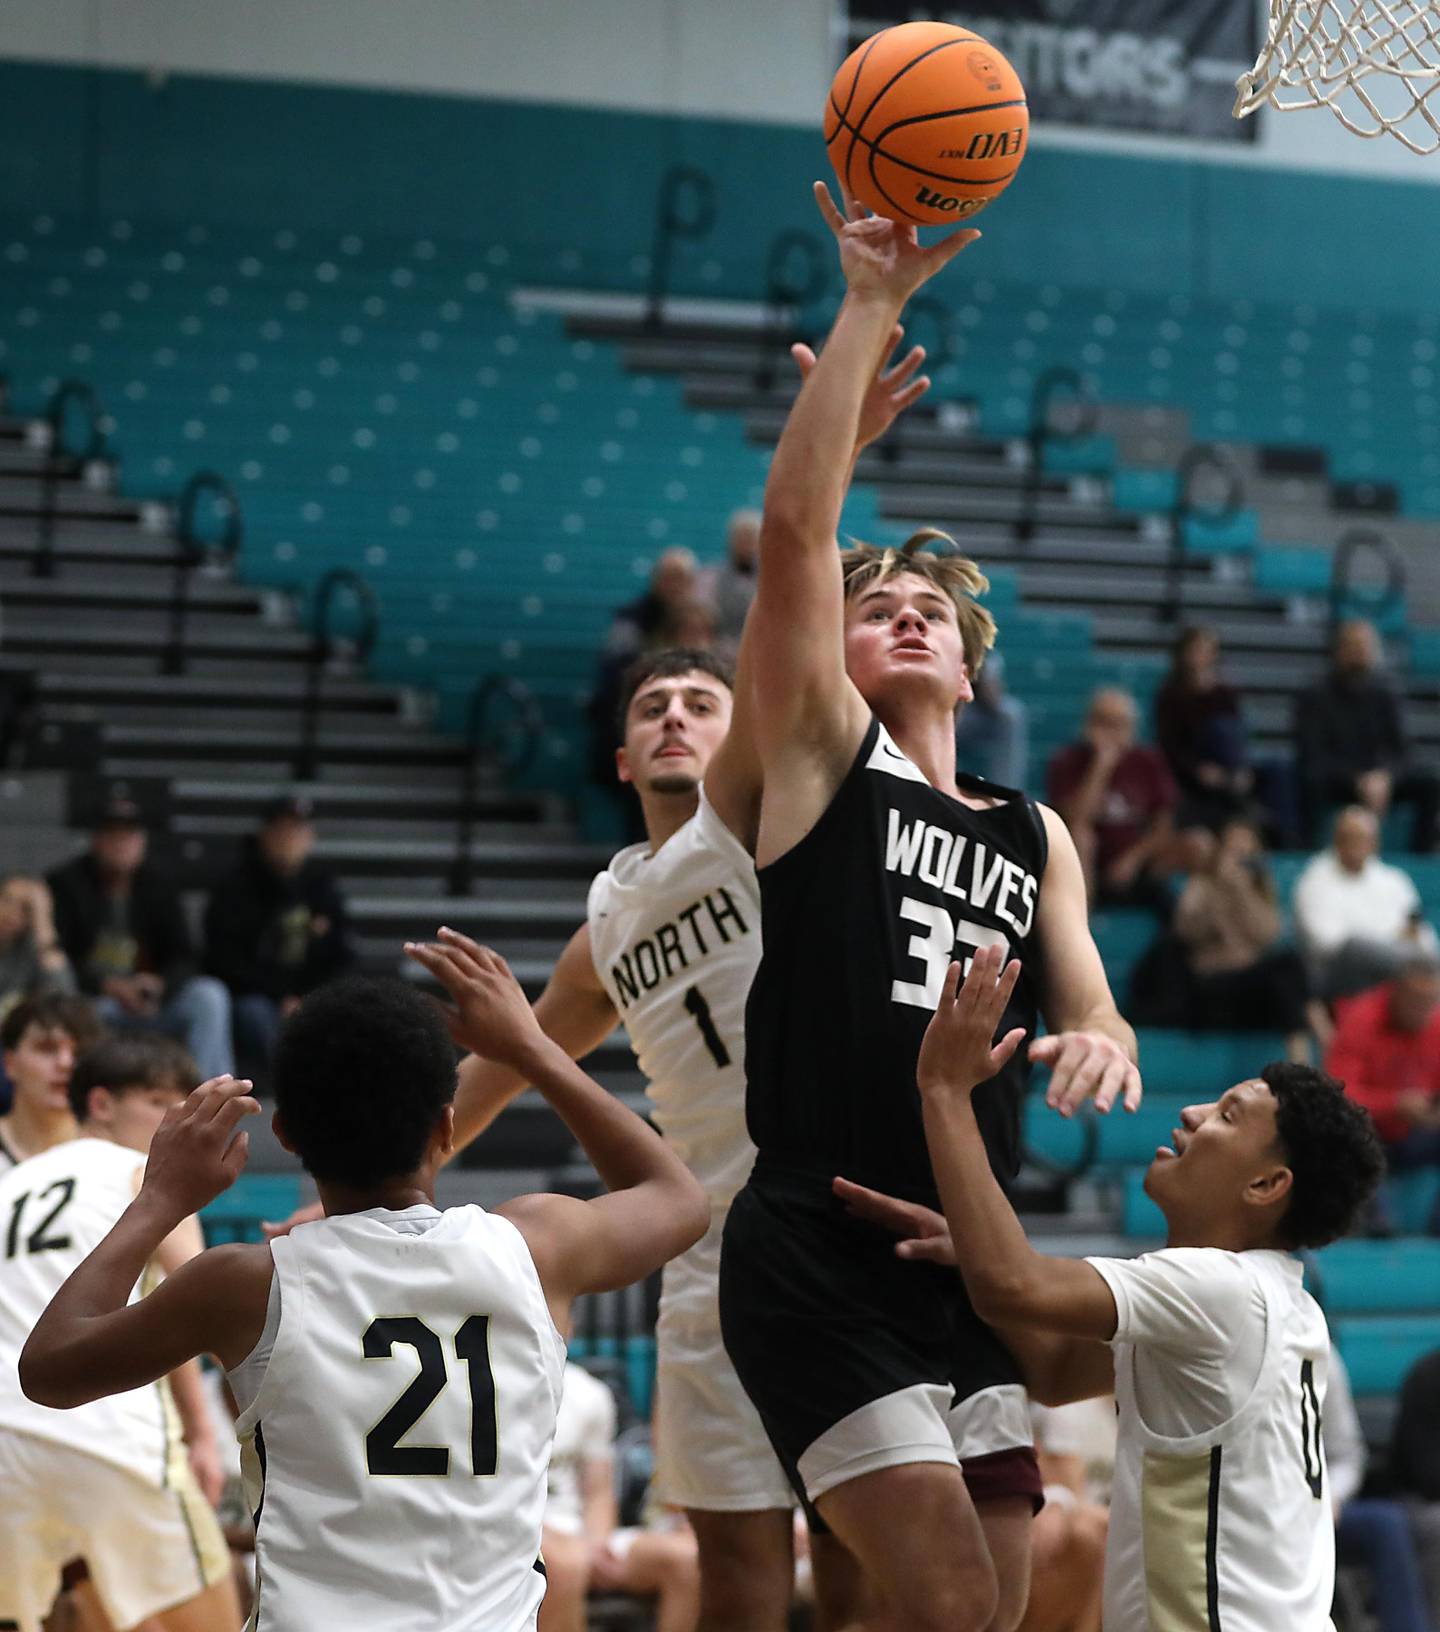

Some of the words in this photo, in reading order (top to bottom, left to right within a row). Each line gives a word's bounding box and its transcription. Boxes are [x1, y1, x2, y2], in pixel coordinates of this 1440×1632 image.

[965, 128, 1023, 160] EVO
[885, 808, 1038, 938] WOLVES
[611, 887, 749, 1008] NORTH
[683, 983, 731, 1069] 1
[6, 1178, 76, 1259] 12
[361, 1313, 498, 1479] 21
[1300, 1358, 1323, 1500] 0
